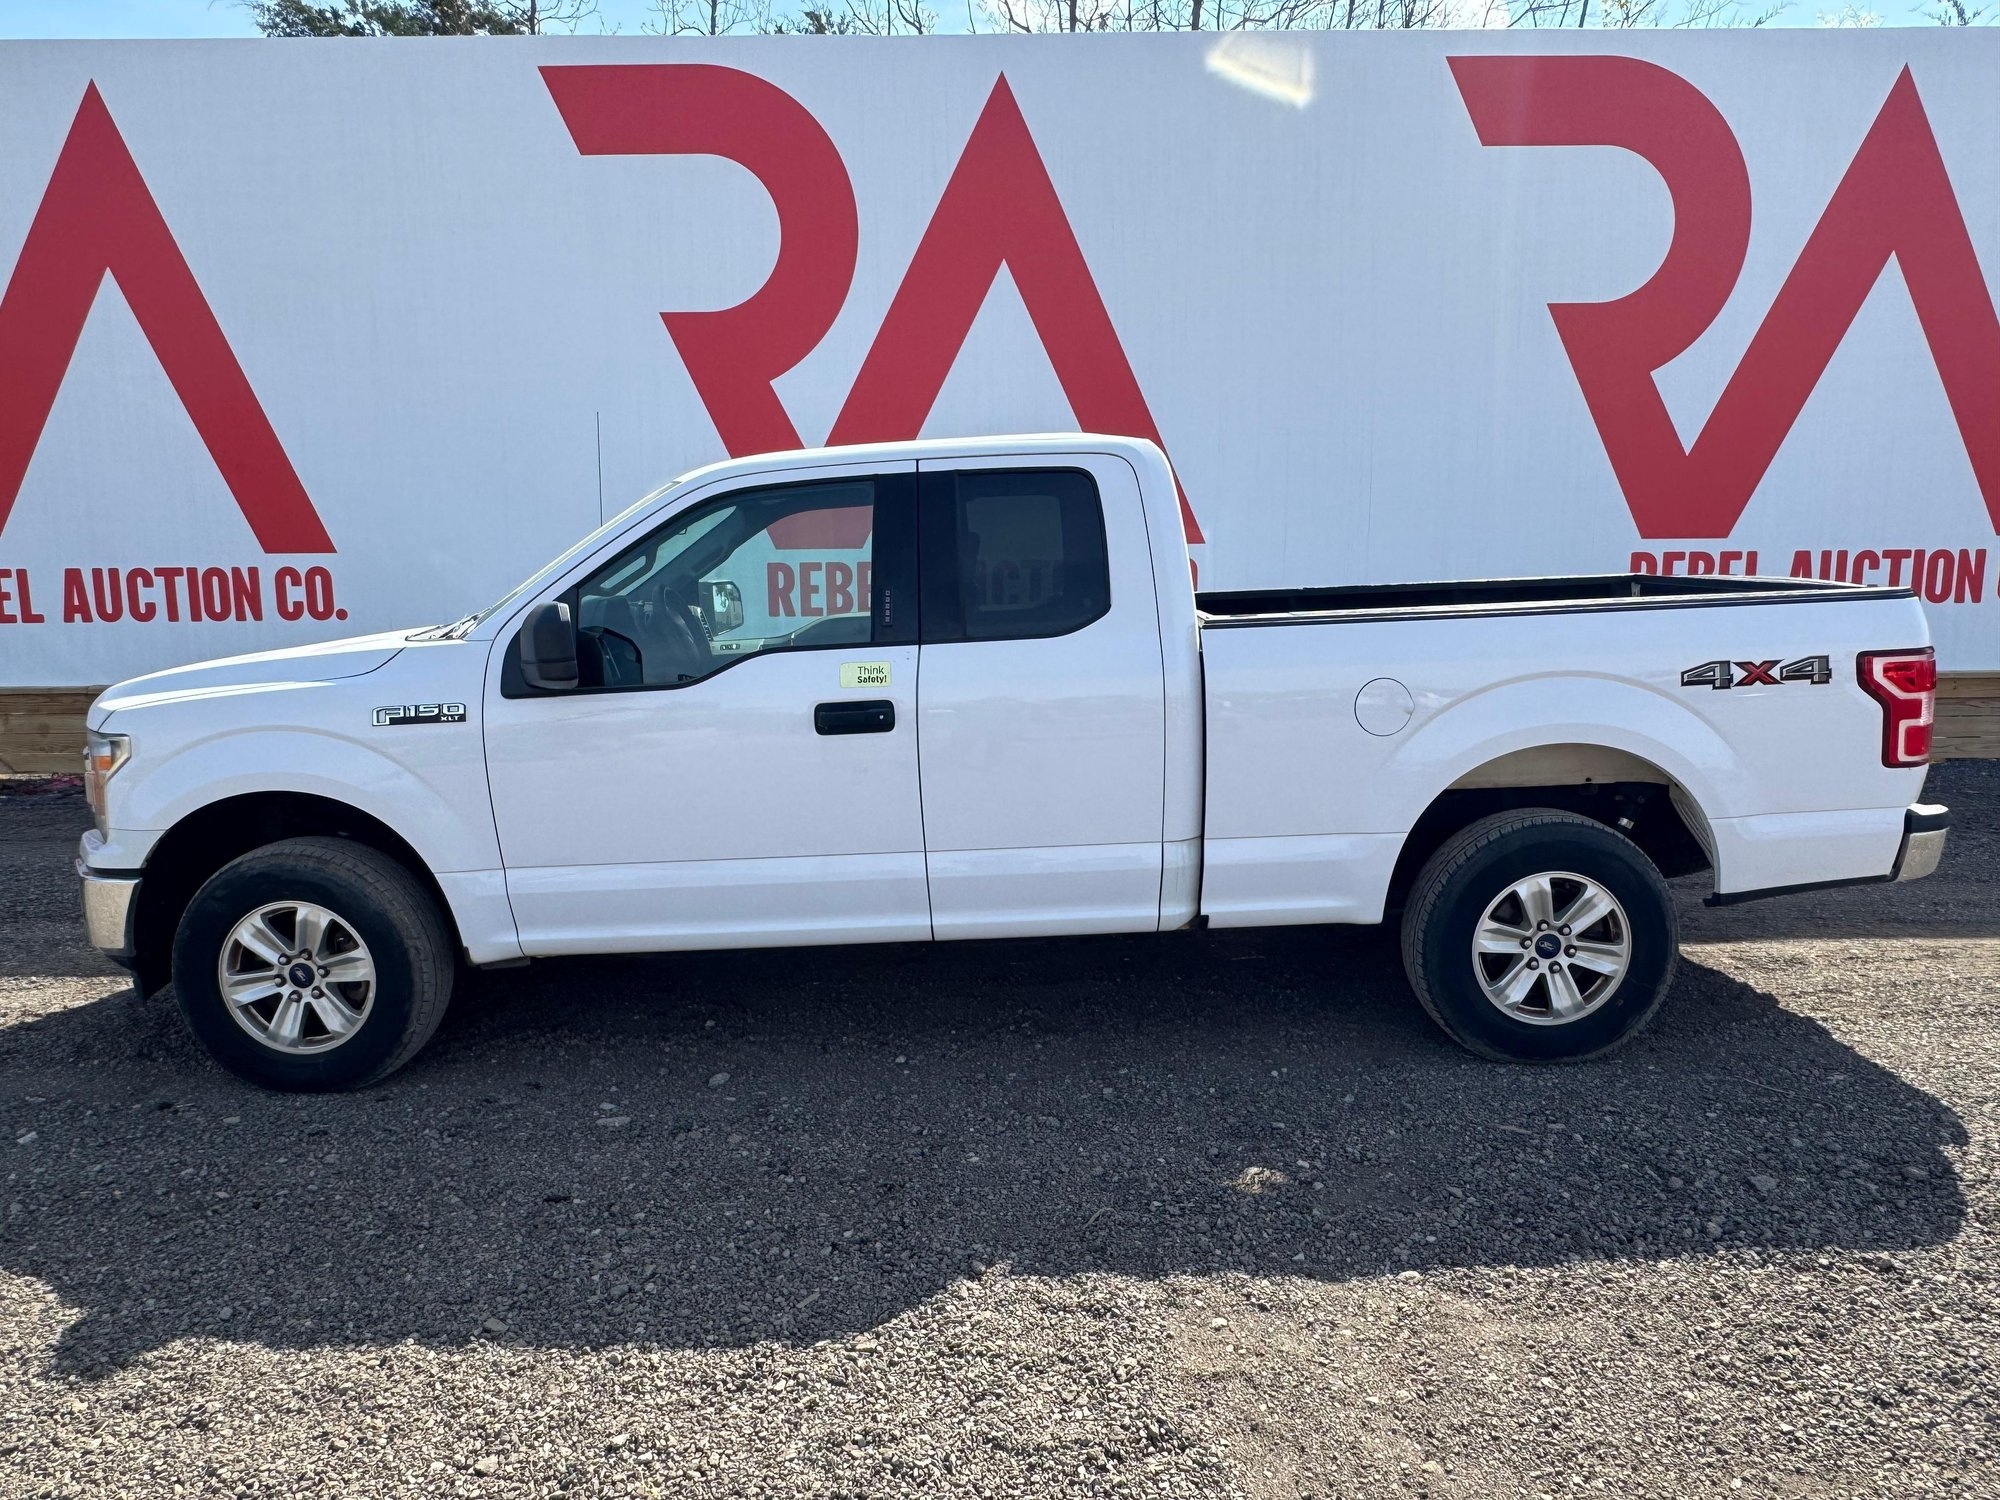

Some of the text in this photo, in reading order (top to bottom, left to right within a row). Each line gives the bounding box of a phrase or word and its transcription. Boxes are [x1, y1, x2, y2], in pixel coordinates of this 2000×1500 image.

[1445, 54, 2000, 539] RA
[63, 566, 263, 623] AUCTION
[274, 565, 349, 621] CO.
[766, 561, 872, 617] REBE
[857, 665, 885, 675] Think
[857, 674, 887, 685] Safety!
